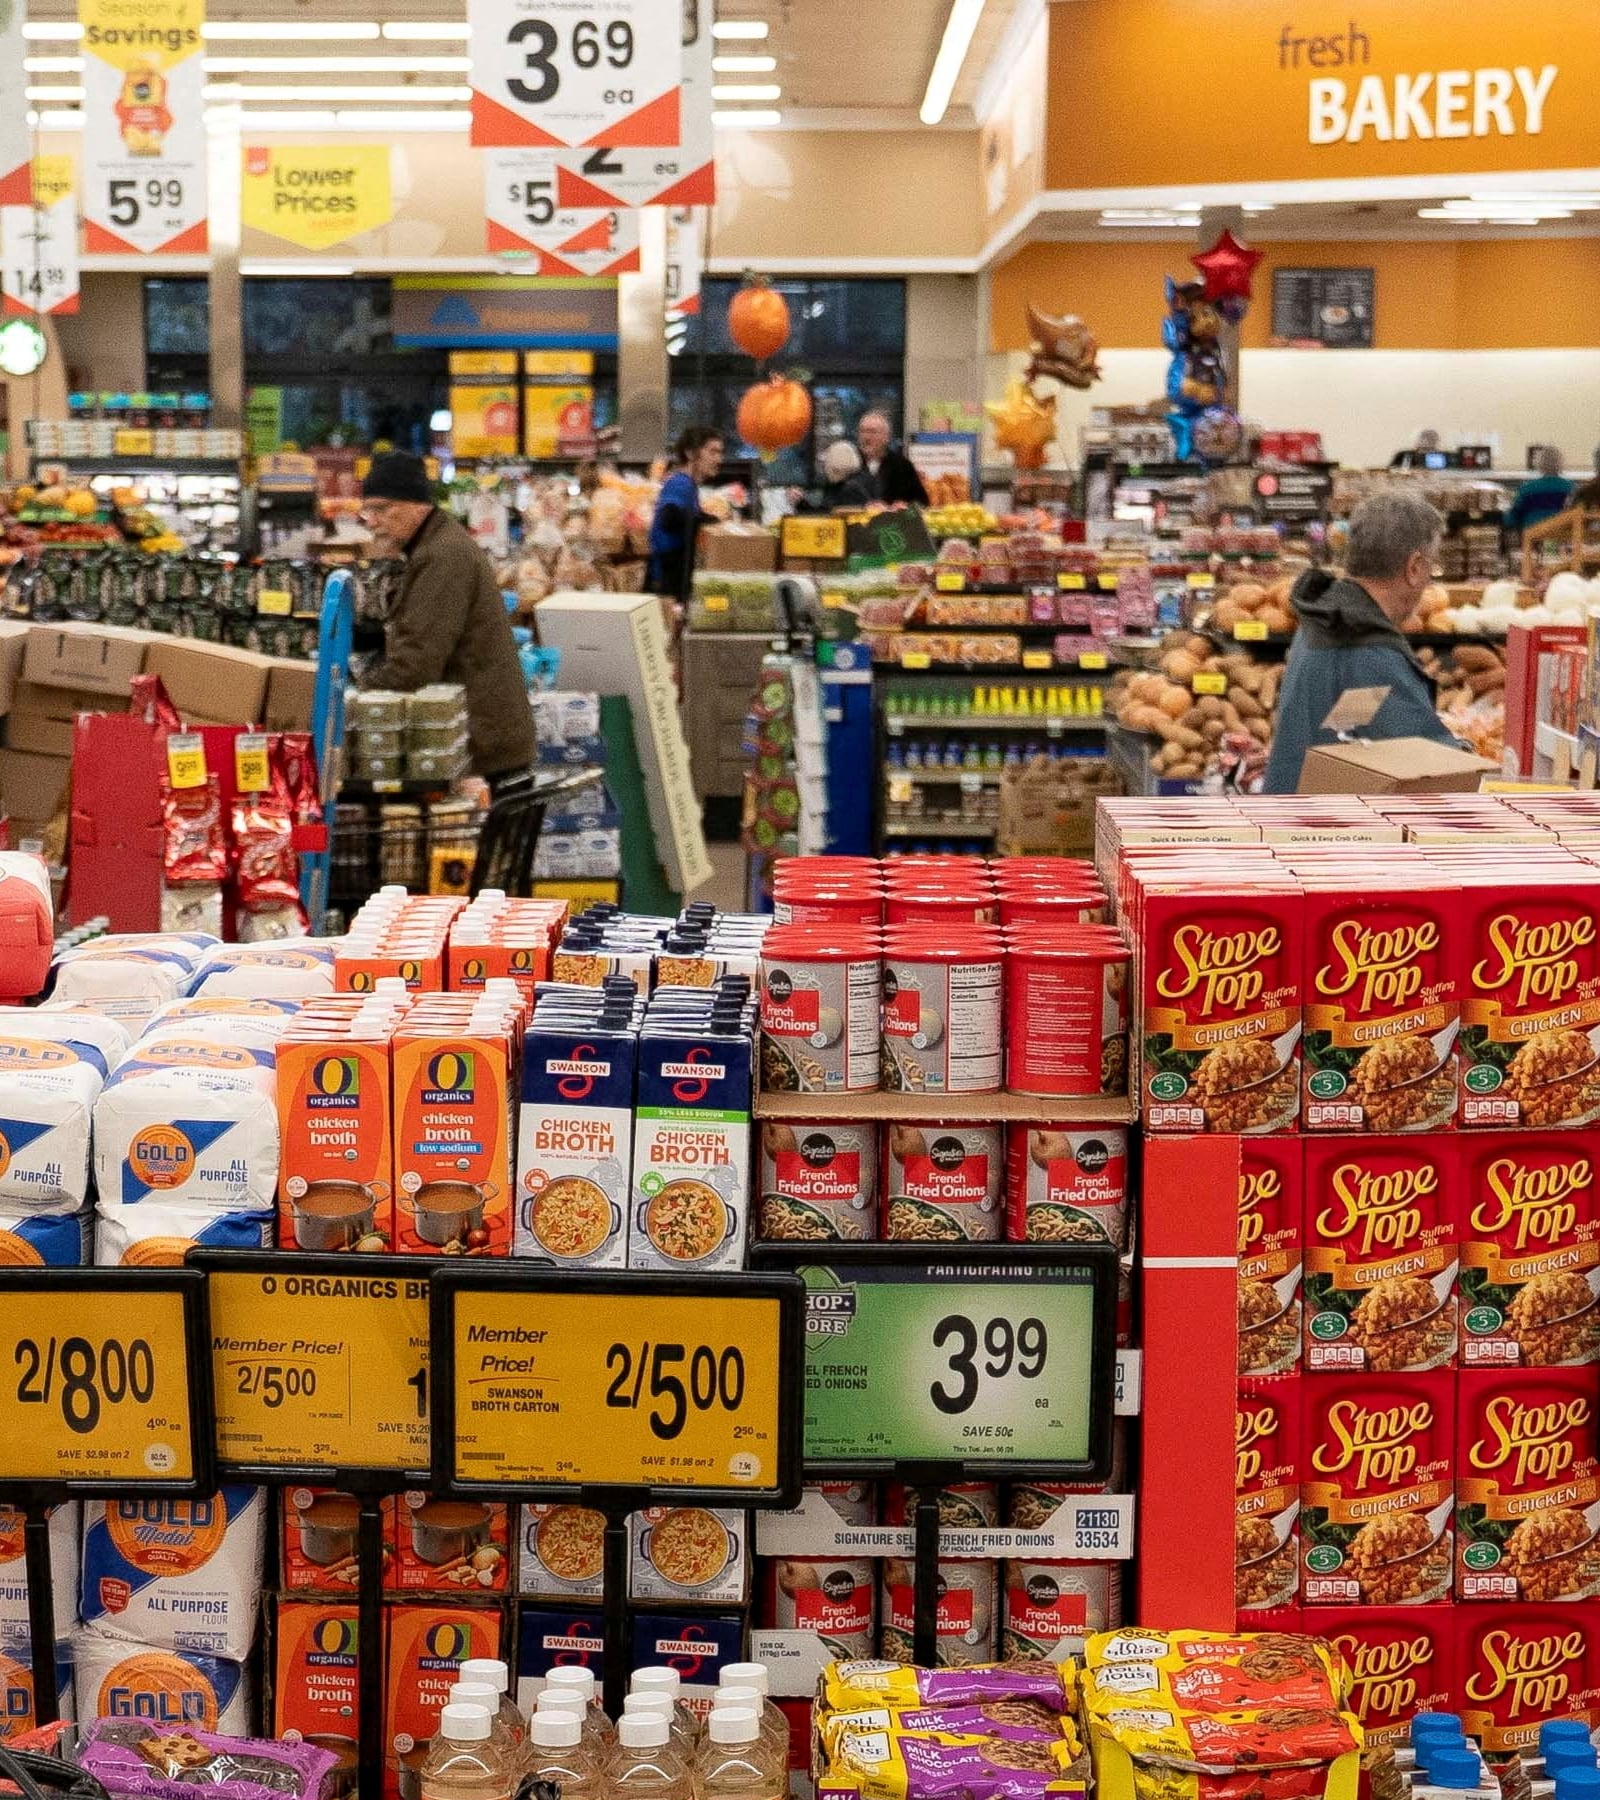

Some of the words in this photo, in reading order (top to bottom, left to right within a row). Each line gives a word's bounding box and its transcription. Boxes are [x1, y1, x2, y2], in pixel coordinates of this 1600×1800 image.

[88, 24, 197, 51] Savings
[1278, 23, 1369, 69] fresh
[603, 89, 634, 104] ea
[1308, 65, 1558, 146] BAKERY
[273, 167, 356, 187] Lower
[273, 191, 357, 214] Prices
[951, 966, 983, 974] Nutrition
[540, 1119, 612, 1134] CHICKEN
[419, 1144, 436, 1153] low
[438, 1143, 477, 1153] sodium
[45, 1162, 63, 1176] ALL
[800, 1169, 838, 1182] French
[13, 1171, 63, 1186] PURPOSE
[261, 1277, 277, 1294] O
[285, 1277, 398, 1299] ORGANICS
[487, 1388, 543, 1399] SWANSON
[471, 1400, 511, 1412] BROTH
[513, 1401, 560, 1413] CARTON
[962, 1426, 993, 1437] SAVE
[56, 1450, 81, 1459] SAVE
[1077, 1511, 1118, 1527] 21130
[834, 1533, 894, 1545] SIGNATURE
[1075, 1531, 1119, 1548] 33534
